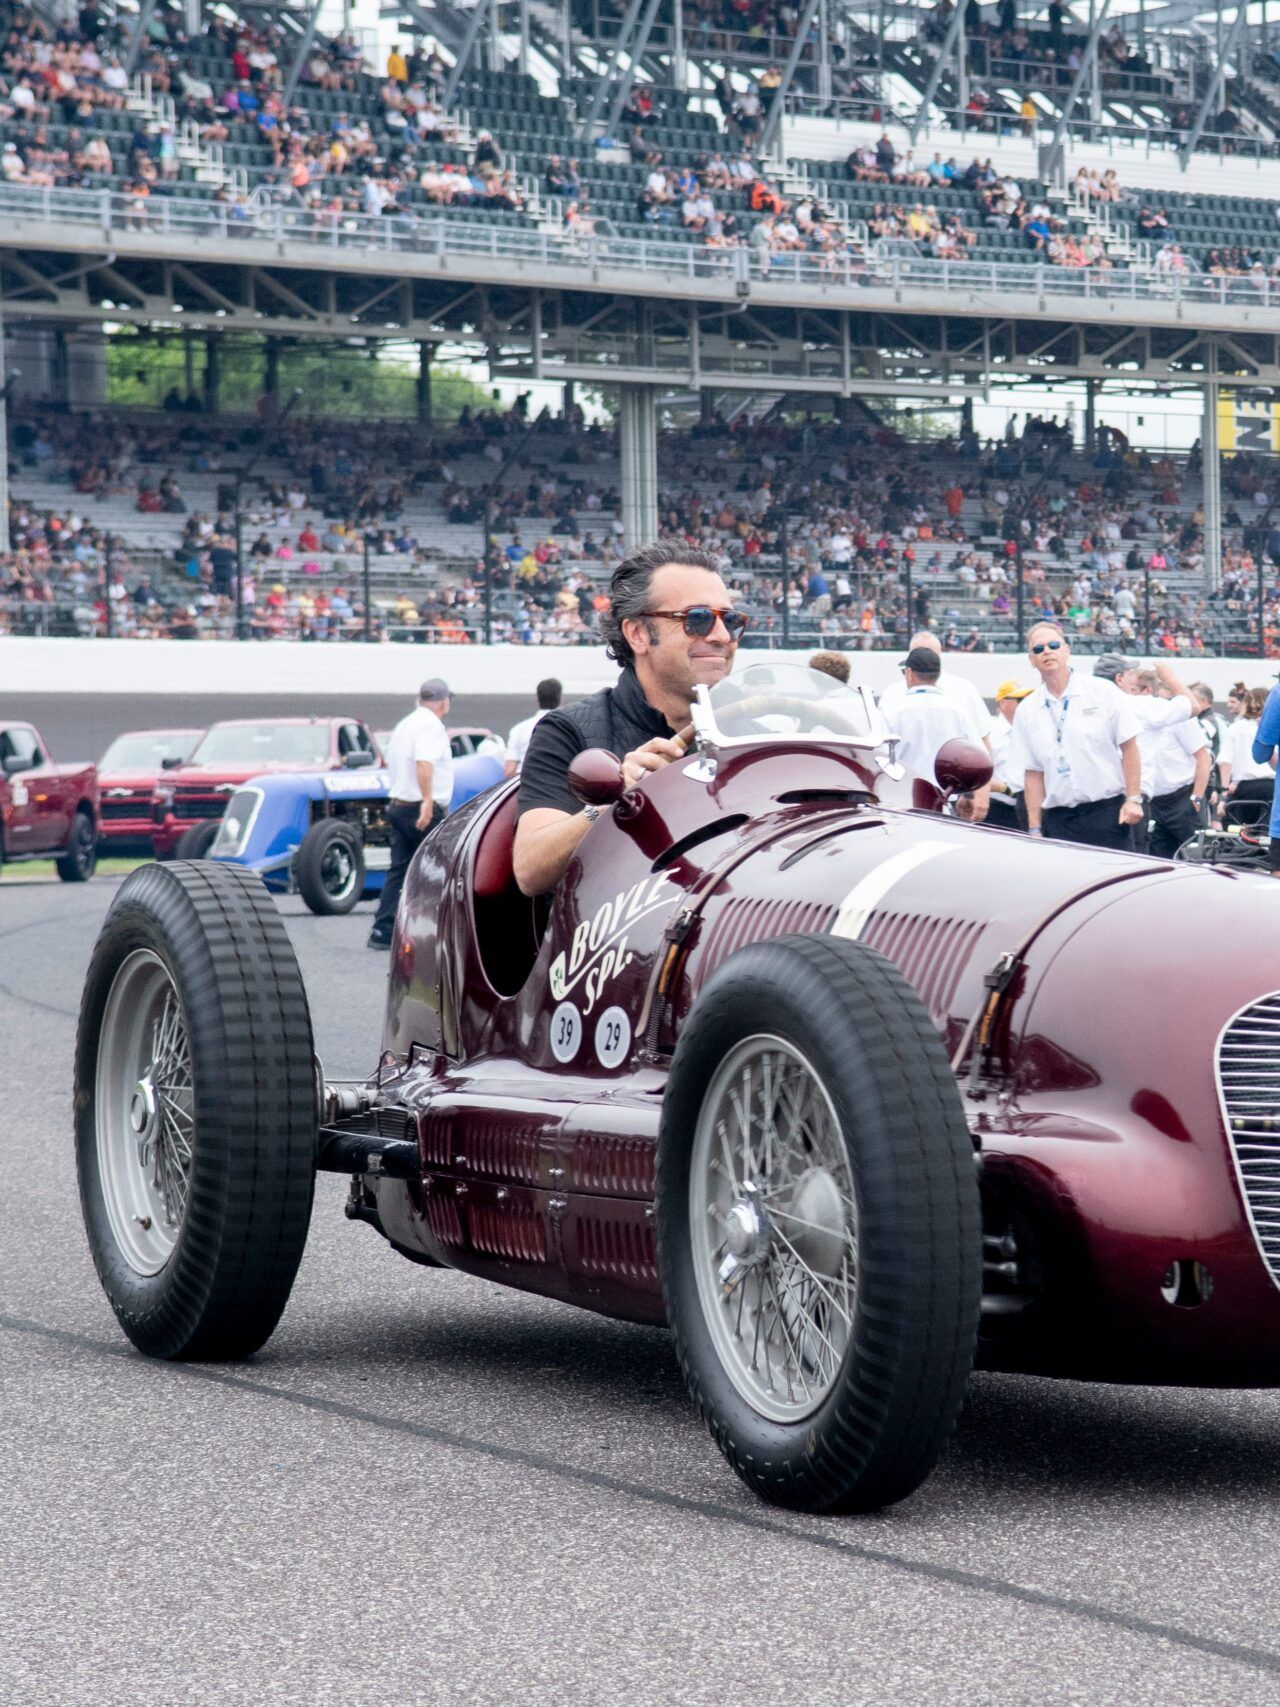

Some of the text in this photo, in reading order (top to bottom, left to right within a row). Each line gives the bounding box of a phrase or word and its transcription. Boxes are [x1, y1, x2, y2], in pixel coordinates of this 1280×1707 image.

[569, 867, 681, 975] BOYLE
[558, 1016, 573, 1046] 39
[604, 1022, 621, 1051] 29
